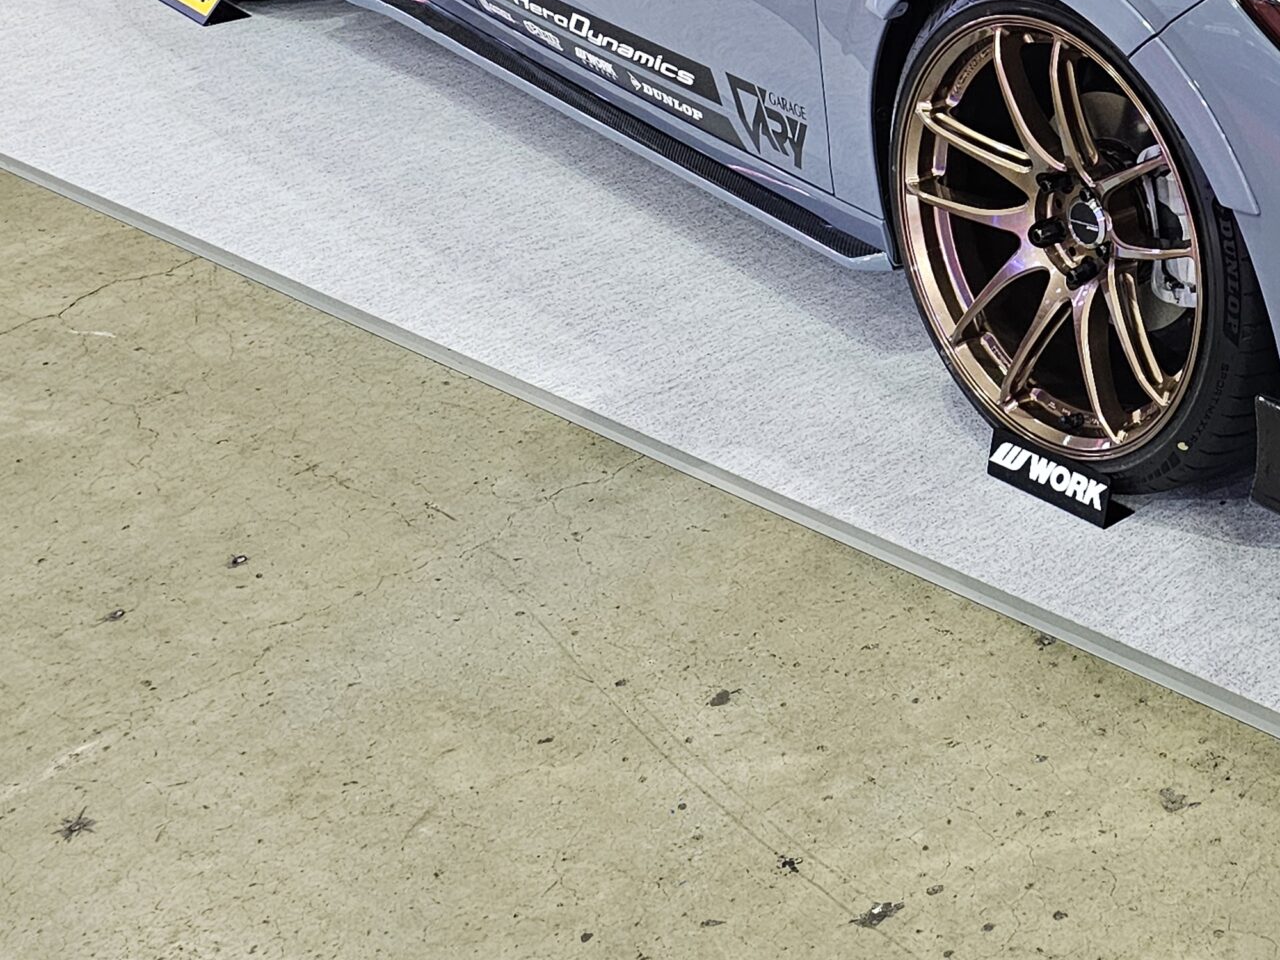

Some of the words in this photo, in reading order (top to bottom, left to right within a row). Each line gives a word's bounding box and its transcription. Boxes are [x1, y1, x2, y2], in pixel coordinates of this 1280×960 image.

[641, 82, 704, 121] DUNLOP
[768, 91, 808, 121] GARAGE
[1218, 217, 1241, 336] DUNLOP
[1027, 452, 1109, 512] WORK
